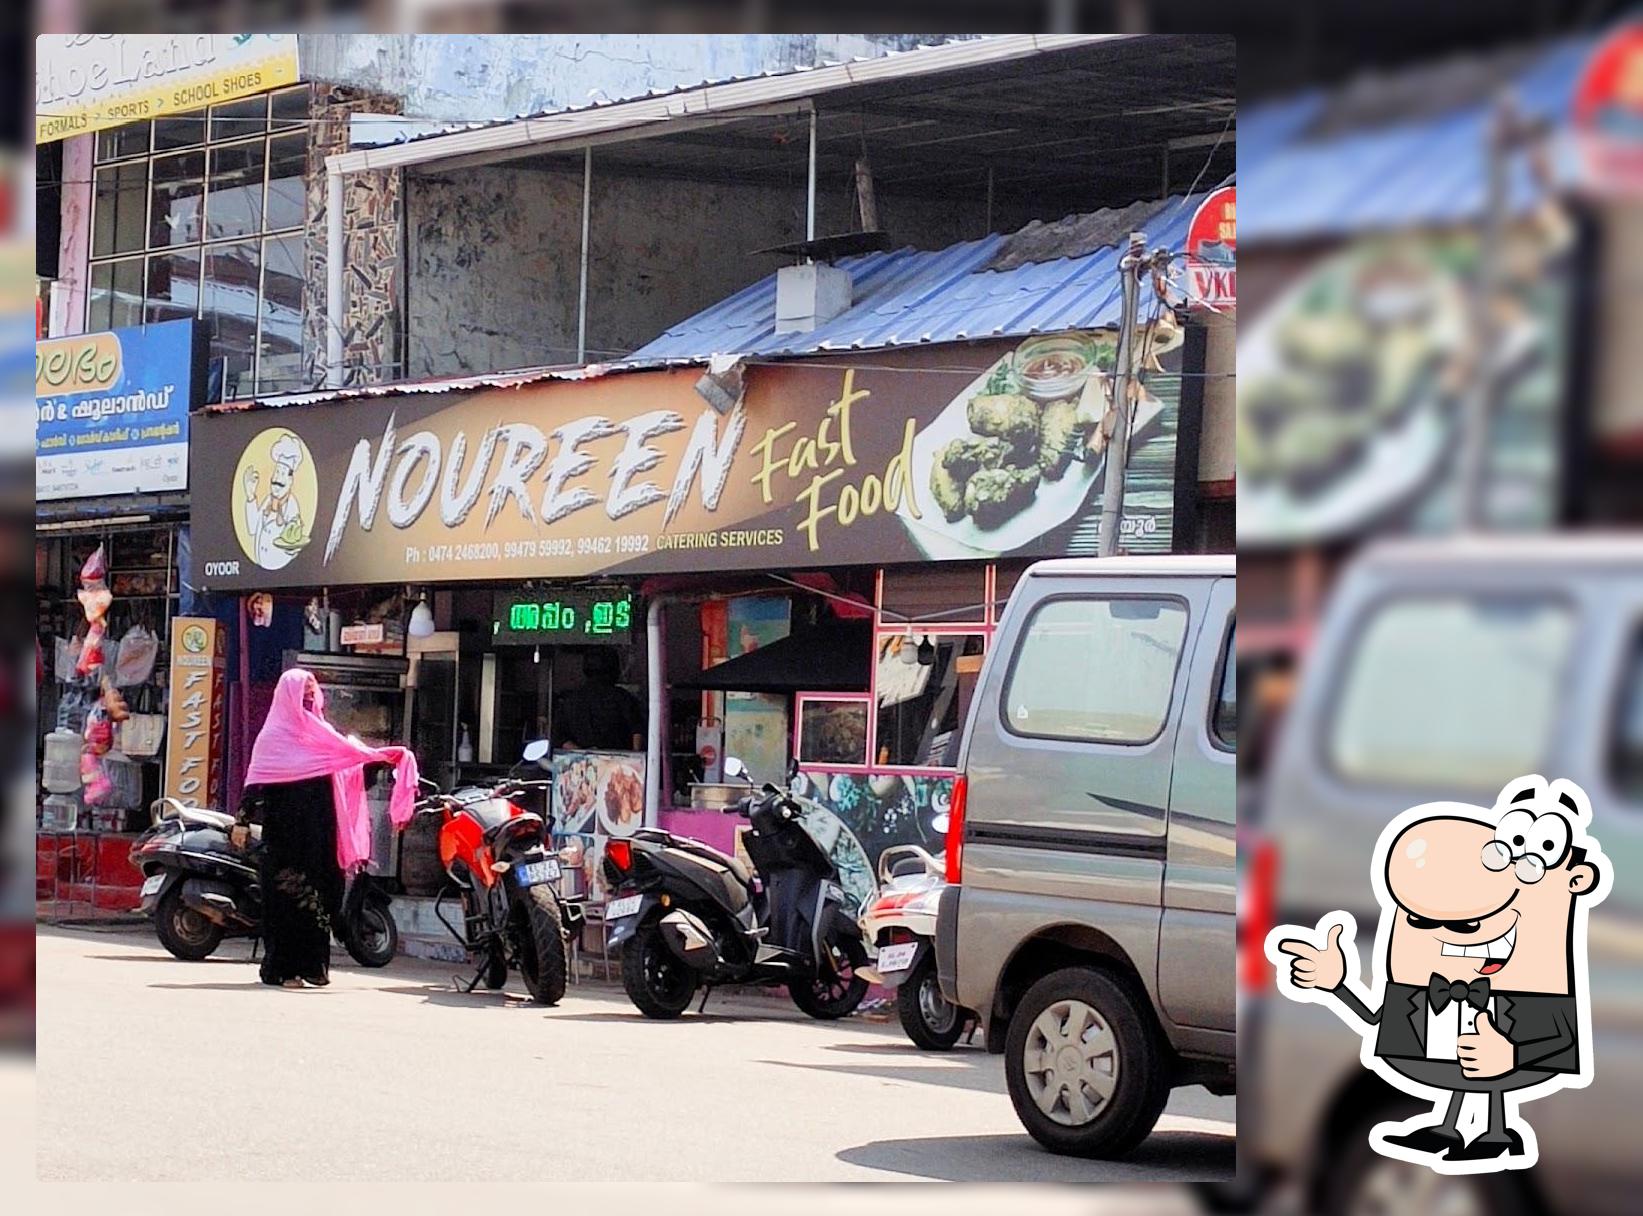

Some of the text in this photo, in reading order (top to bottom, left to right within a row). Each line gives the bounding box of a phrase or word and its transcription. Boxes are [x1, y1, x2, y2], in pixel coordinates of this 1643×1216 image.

[39, 72, 262, 138] FORMALS SPORTS SCHOOL SHOES
[750, 369, 871, 503] Fast
[322, 393, 748, 568] NOUREEN
[796, 418, 922, 551] Food
[204, 560, 240, 577] OYOOR
[577, 536, 611, 555] 99462
[614, 534, 650, 552] 19992
[656, 529, 784, 551] CATERING SERVICES
[179, 669, 209, 750] FAST
